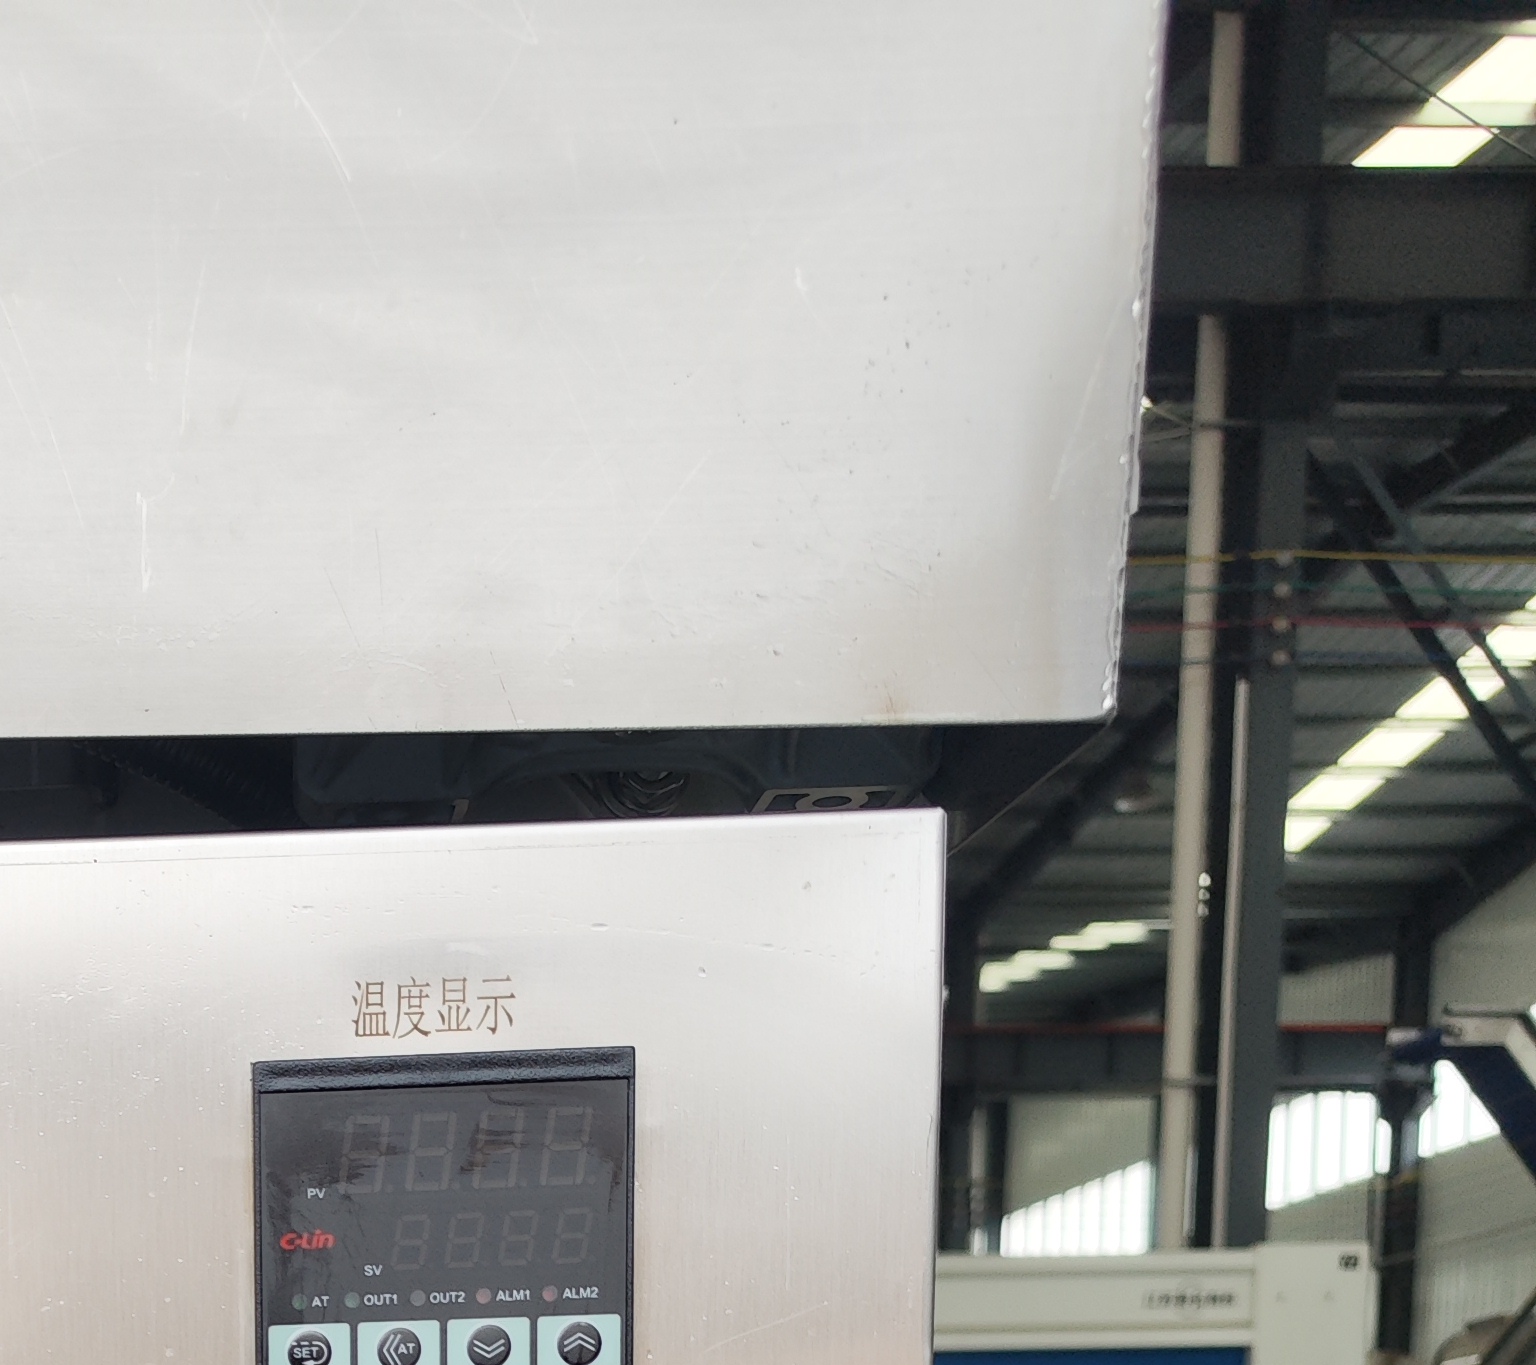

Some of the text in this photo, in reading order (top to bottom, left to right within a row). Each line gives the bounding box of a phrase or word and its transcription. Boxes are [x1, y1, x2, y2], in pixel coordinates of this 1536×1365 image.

[351, 975, 517, 1040] 温度显示
[306, 1187, 326, 1200] PV
[363, 1264, 383, 1277] SV
[311, 1286, 599, 1308] AT OUT1 OUT2 ALM1 ALM2
[292, 1346, 319, 1359] SET
[397, 1342, 416, 1355] AT
